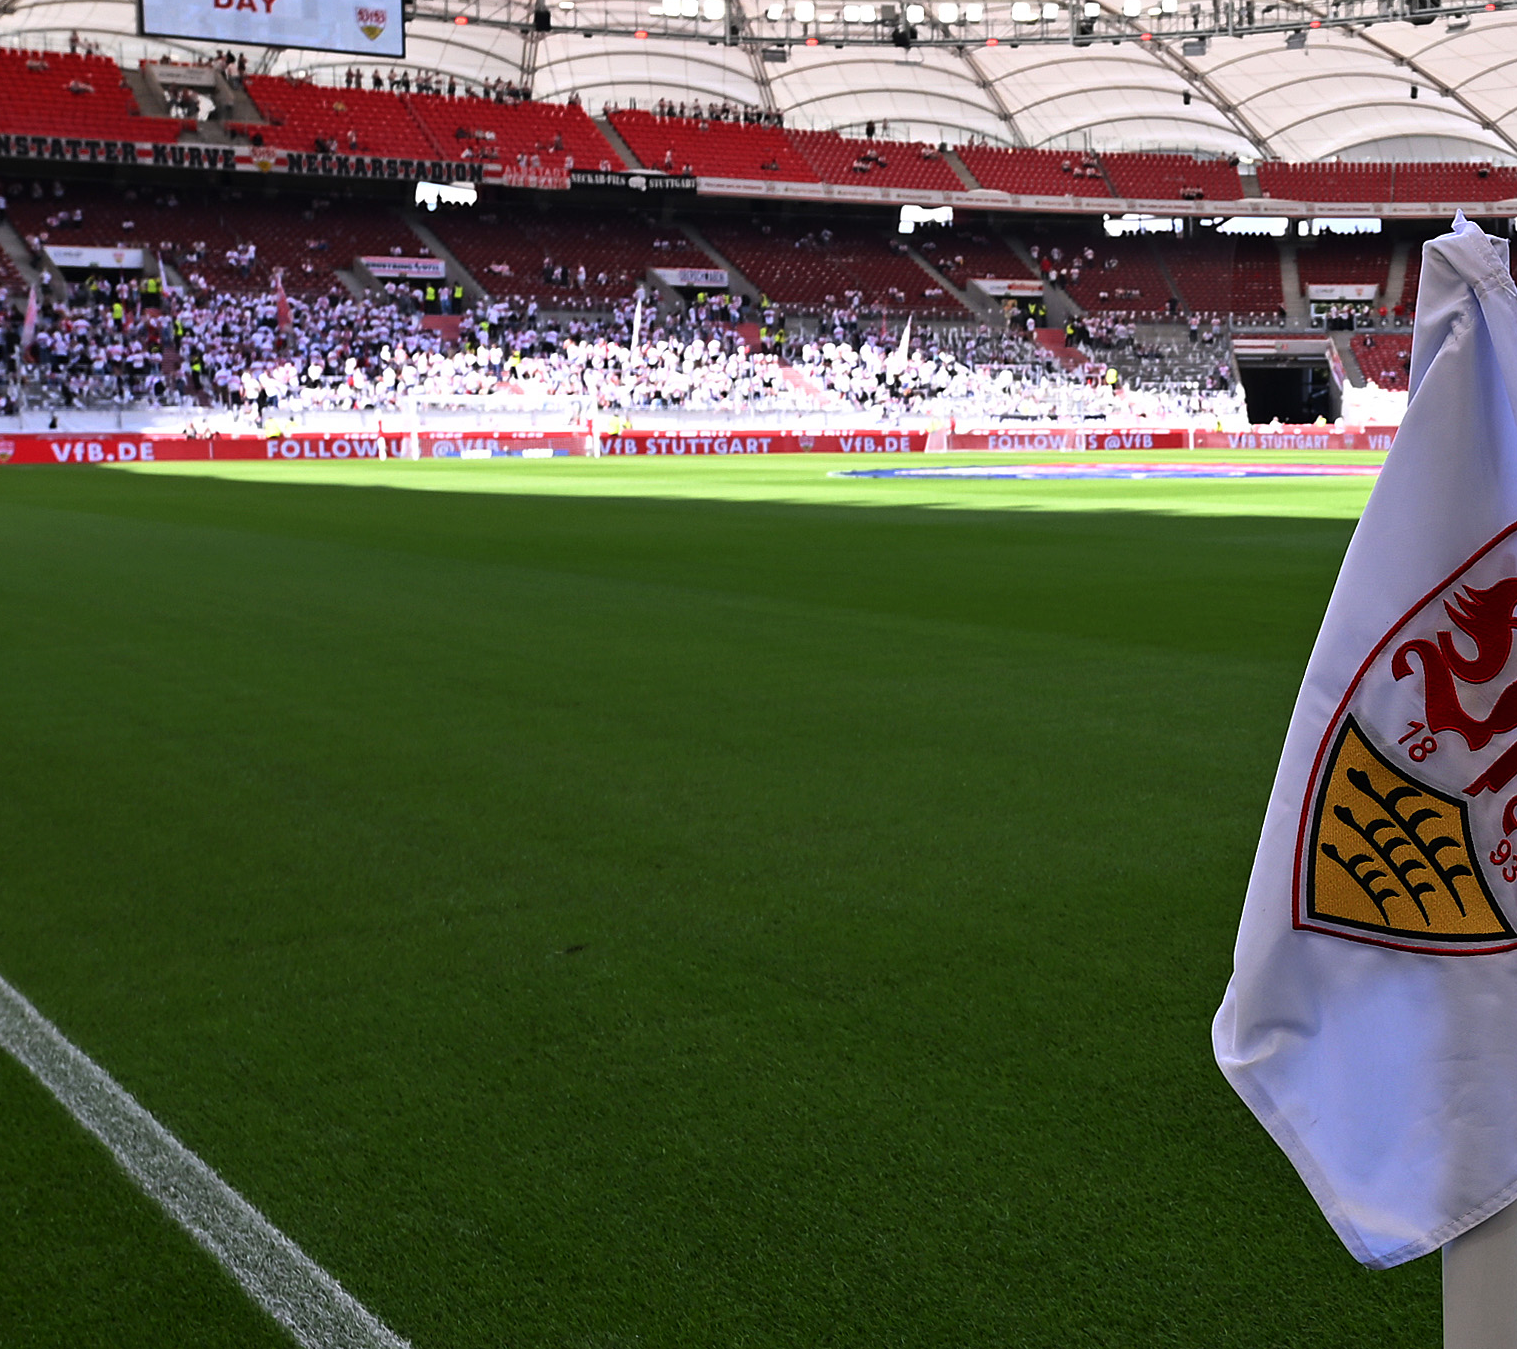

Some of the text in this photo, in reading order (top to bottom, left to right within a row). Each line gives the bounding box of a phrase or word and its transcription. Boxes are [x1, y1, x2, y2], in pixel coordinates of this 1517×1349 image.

[152, 144, 236, 170] KURVE
[287, 153, 483, 182] NECKARSTADION
[267, 440, 379, 458] FOLLOW
[599, 437, 772, 455] VfB STUTTGART
[840, 437, 910, 452] VfB.DE
[989, 434, 1068, 450] FOLLOW
[1105, 434, 1153, 450] @VfB
[1261, 434, 1329, 449] STUTTGART
[51, 442, 155, 462] VfB.DE
[1398, 721, 1438, 762] 18
